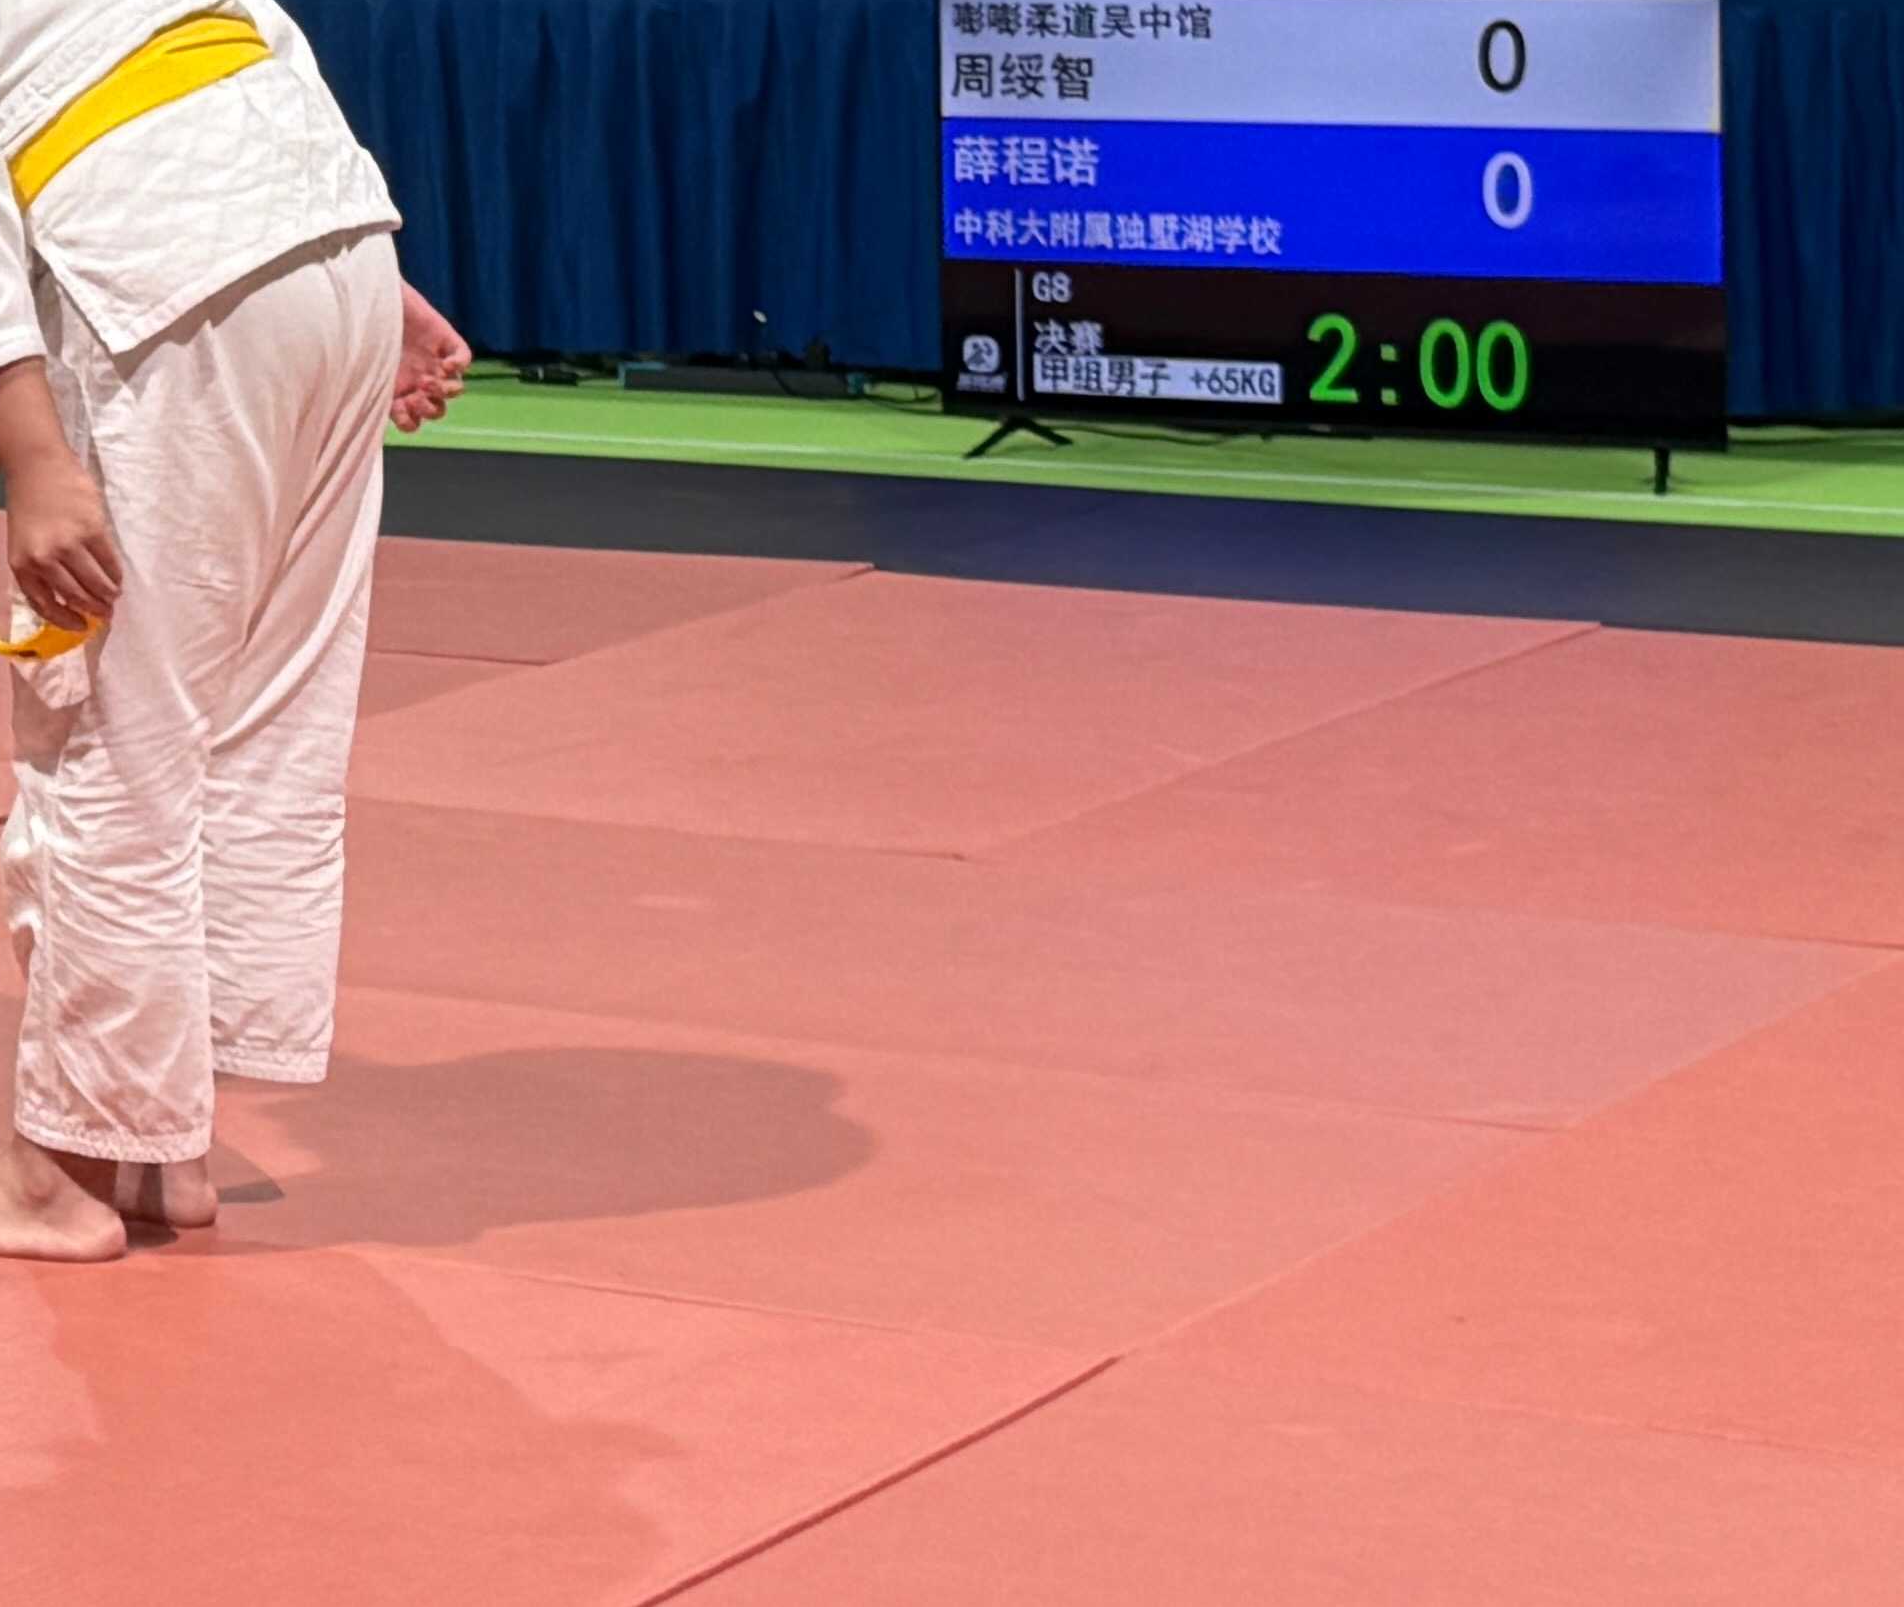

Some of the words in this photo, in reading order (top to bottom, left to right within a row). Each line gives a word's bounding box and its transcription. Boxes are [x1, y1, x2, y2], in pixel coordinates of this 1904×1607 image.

[952, 52, 1094, 100] 周绥智
[1478, 19, 1527, 93] 0
[953, 135, 1100, 186] 薛程诺
[1482, 151, 1534, 229] 0
[1033, 273, 1072, 303] G8
[1033, 319, 1104, 356] 决赛
[1041, 356, 1171, 396] 甲组男子
[1190, 367, 1276, 397] +65KG
[1307, 314, 1530, 411] 2:00
